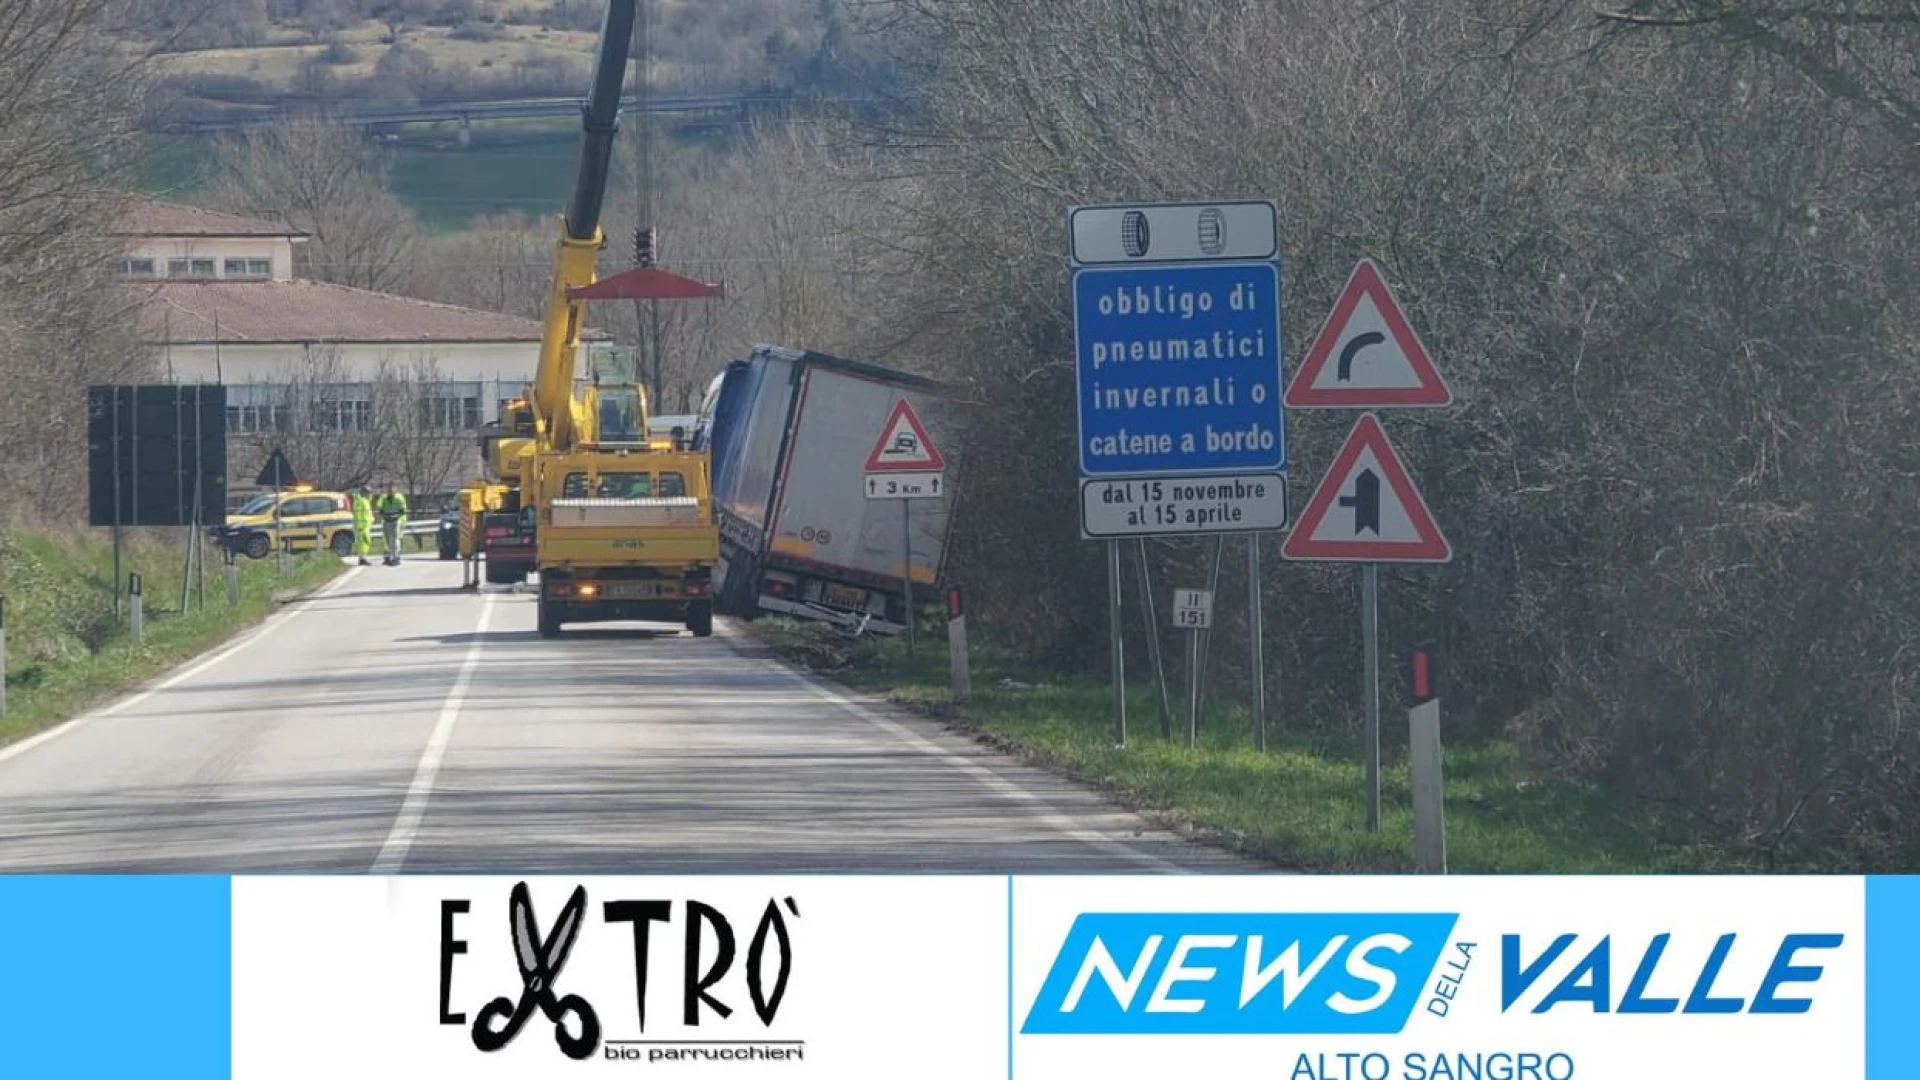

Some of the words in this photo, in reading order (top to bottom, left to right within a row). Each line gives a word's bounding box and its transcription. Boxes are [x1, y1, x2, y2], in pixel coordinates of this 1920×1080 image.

[1098, 285, 1213, 318] obbligo
[1229, 284, 1256, 311] di
[1093, 330, 1265, 369] pneumatici
[1093, 376, 1235, 409] invernali
[1251, 383, 1266, 404] o
[1089, 429, 1173, 456] catene
[1181, 432, 1195, 454] a
[1206, 423, 1274, 452] bordo
[886, 481, 898, 495] 3
[1103, 483, 1132, 503] dal
[1141, 482, 1163, 502] 15
[1173, 482, 1266, 502] novembre
[1127, 506, 1147, 525] al
[1155, 505, 1177, 524] 15
[1186, 504, 1242, 529] aprile
[1180, 610, 1205, 626] 151
